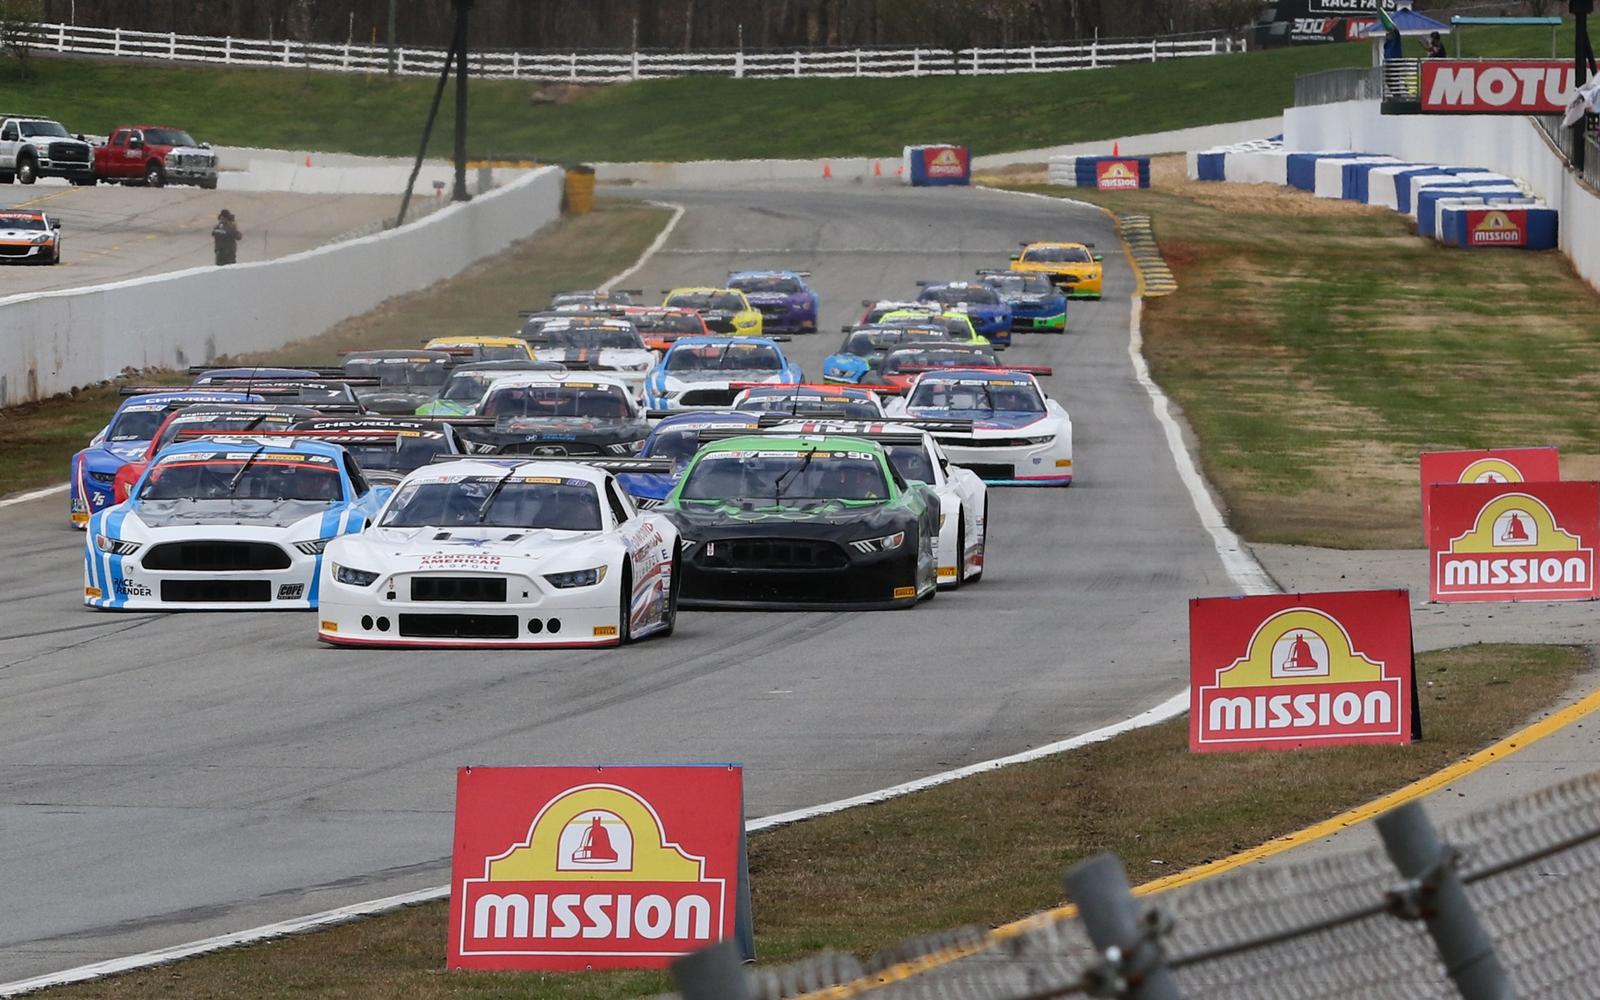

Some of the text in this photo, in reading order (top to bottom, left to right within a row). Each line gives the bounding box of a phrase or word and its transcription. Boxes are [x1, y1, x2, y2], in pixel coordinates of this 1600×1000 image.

[1428, 67, 1594, 106] MOTU
[314, 421, 423, 429] CHEVROLET
[116, 587, 152, 596] RENDER
[280, 585, 303, 596] COPE
